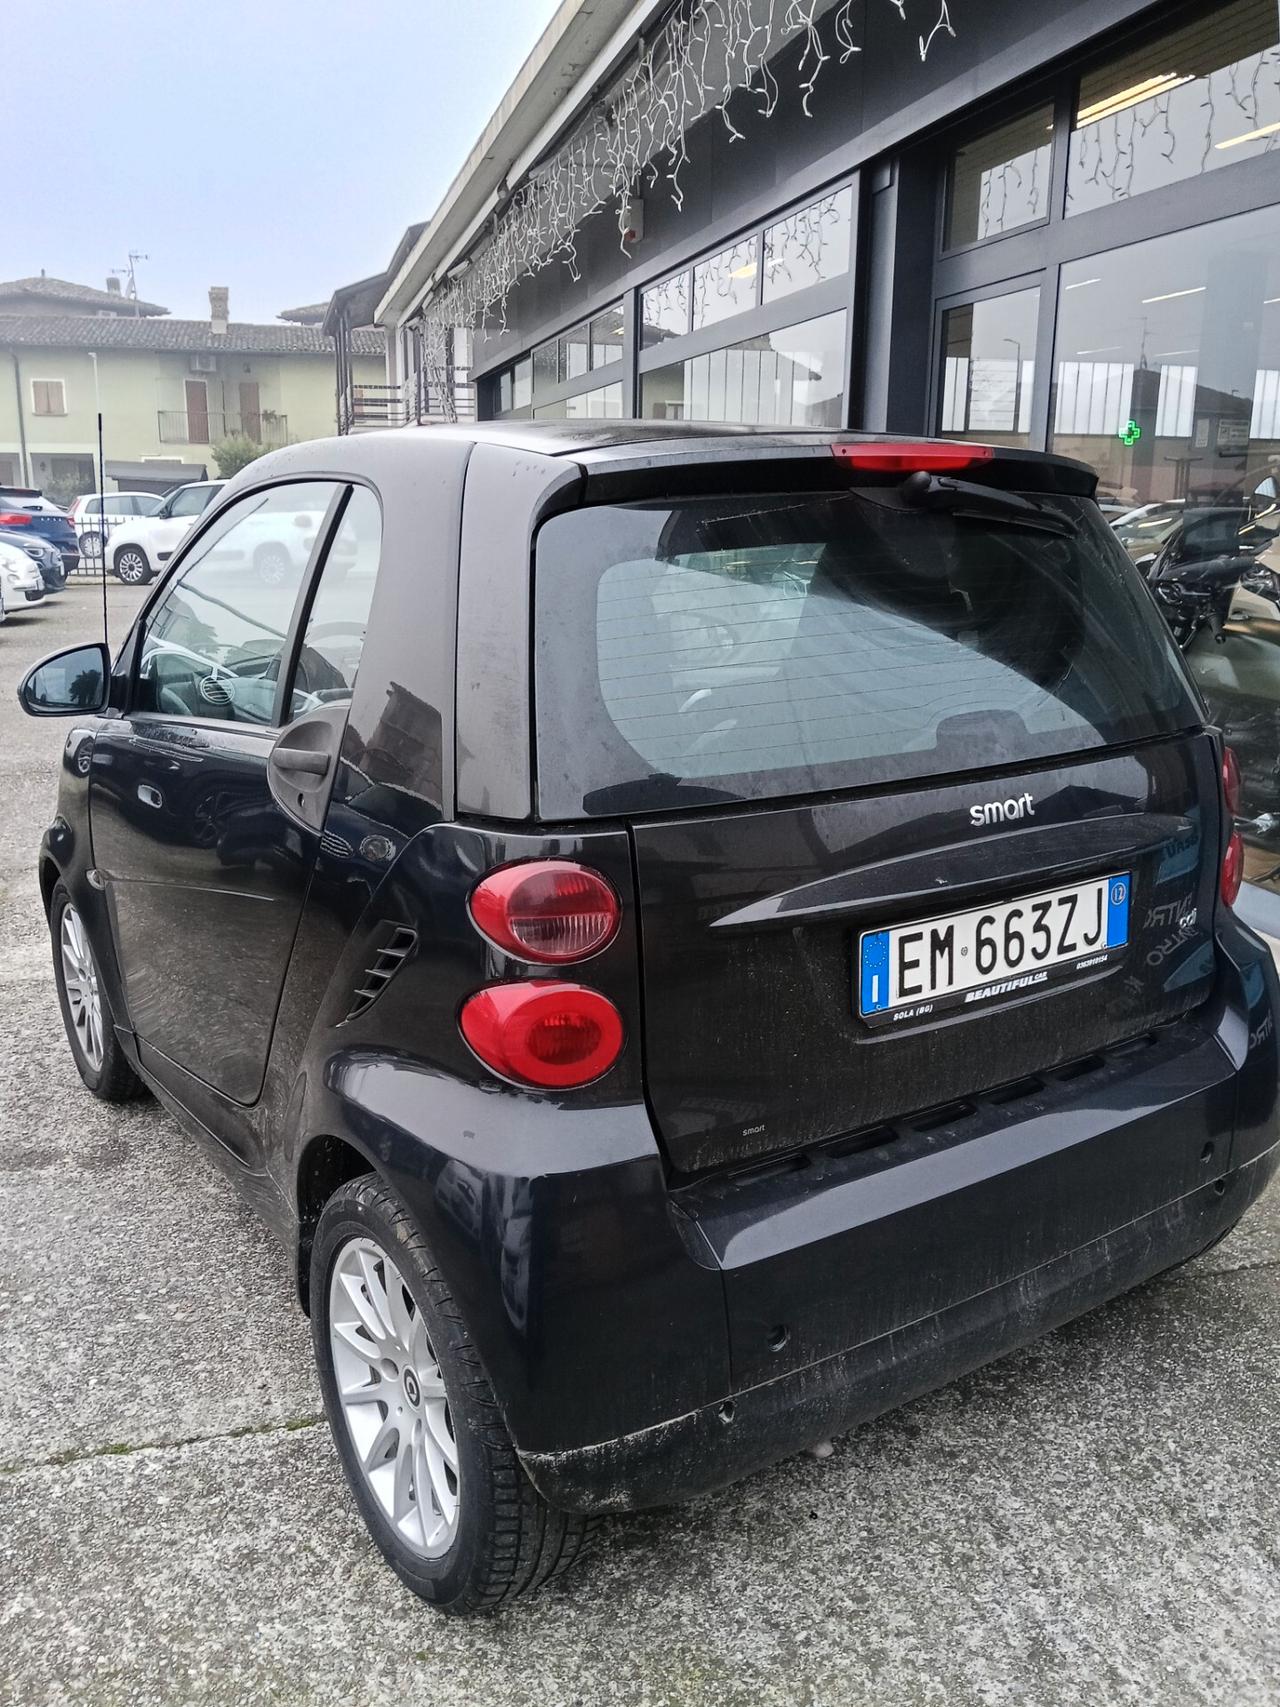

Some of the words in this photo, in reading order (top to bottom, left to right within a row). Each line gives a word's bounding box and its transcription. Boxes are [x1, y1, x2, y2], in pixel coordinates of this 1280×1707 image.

[970, 793, 1035, 826] smart
[1179, 907, 1198, 929] cdi
[899, 925, 954, 998] EM
[975, 887, 1103, 976] 663ZJ
[964, 975, 1035, 1003] BEAUTIFUL
[893, 1008, 914, 1021] SOLA
[916, 1004, 934, 1017] (BG)
[742, 1124, 765, 1136] smart
